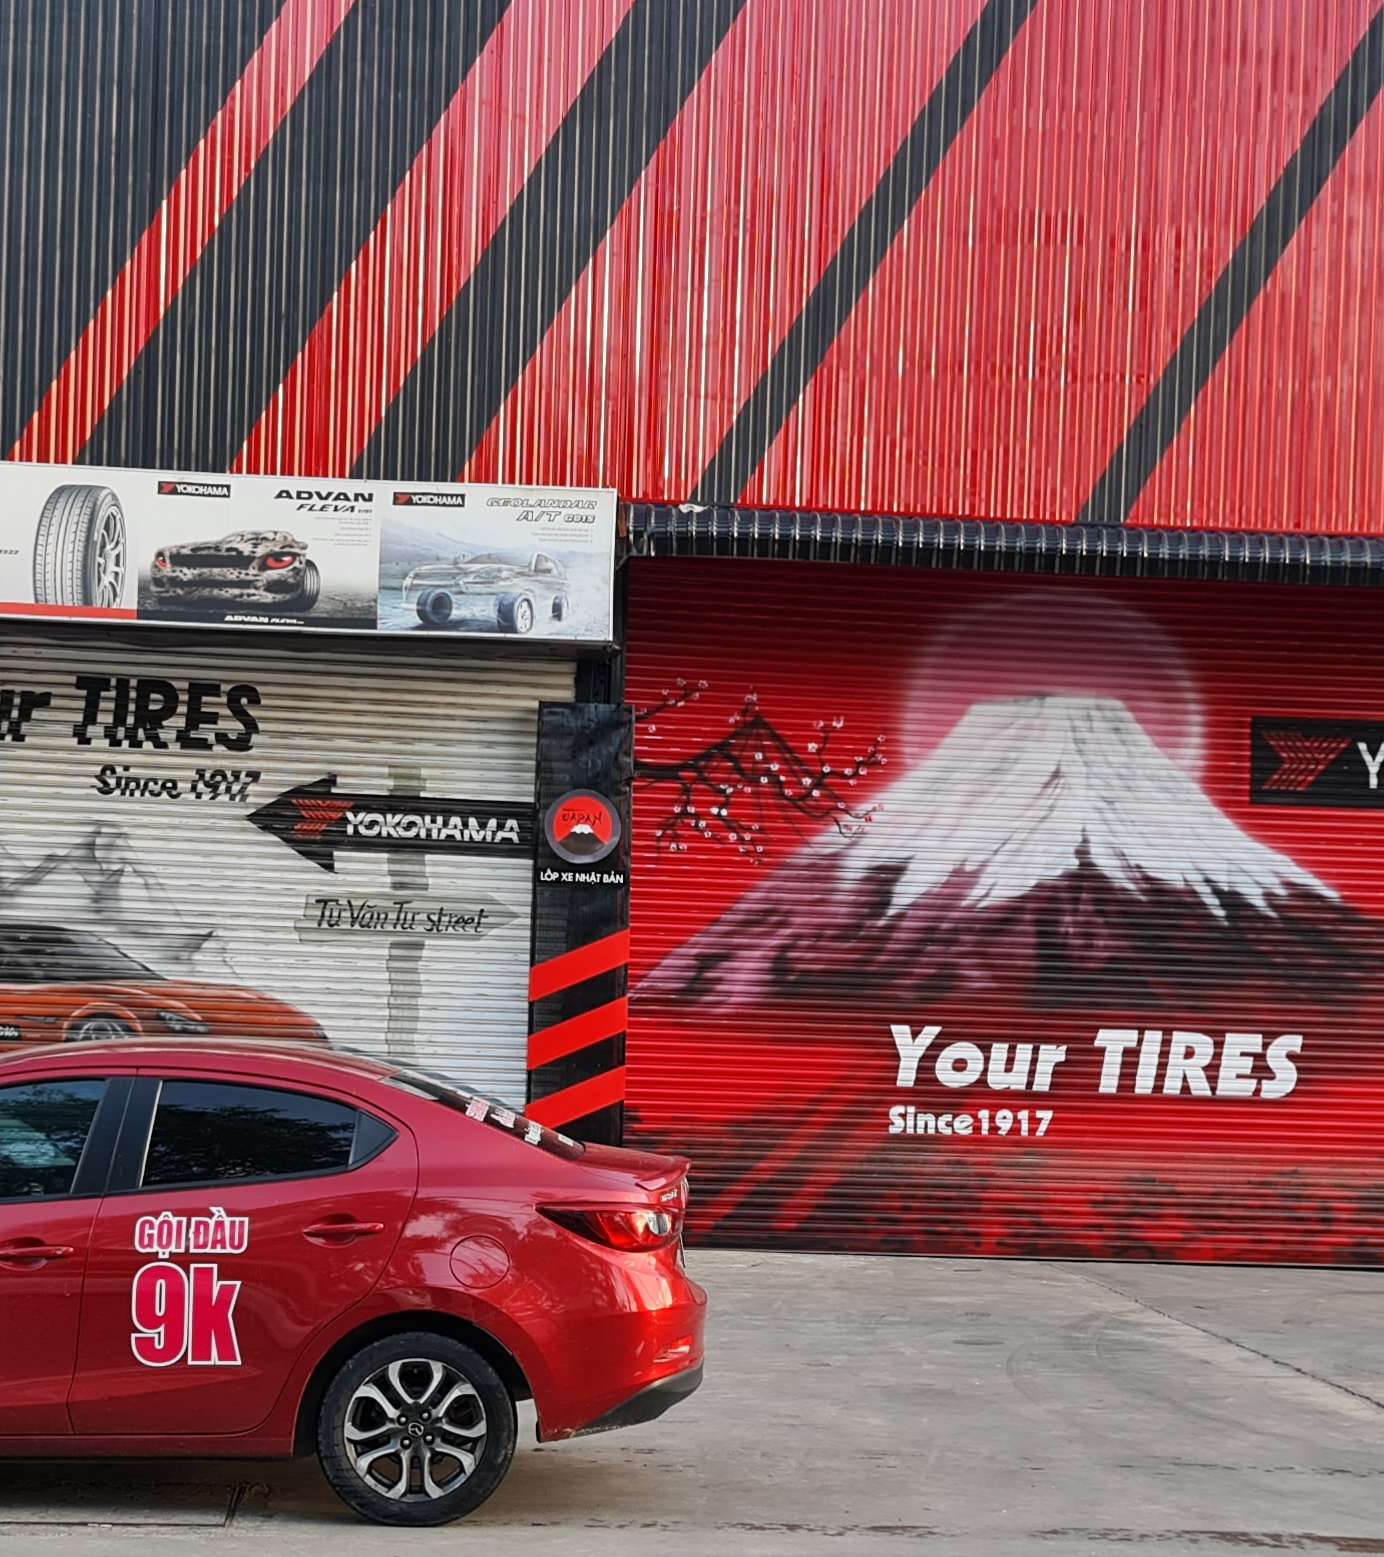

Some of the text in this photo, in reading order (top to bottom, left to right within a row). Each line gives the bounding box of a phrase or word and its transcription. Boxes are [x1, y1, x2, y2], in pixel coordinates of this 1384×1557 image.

[175, 484, 229, 496] YOKOHAMA
[273, 489, 374, 502] ADVAN
[410, 495, 463, 505] YOKOHAMA
[296, 503, 356, 513] FLEVA
[516, 510, 562, 522] A/T
[73, 675, 262, 752] TIRES
[92, 764, 262, 803] Since 1917
[345, 810, 521, 843] YOKOHAMA
[561, 872, 573, 881] XE
[424, 907, 489, 933] street
[890, 1024, 1304, 1099] Your TIRES
[134, 1206, 249, 1259] GỘI ĐẦU
[131, 1262, 242, 1367] 9k
